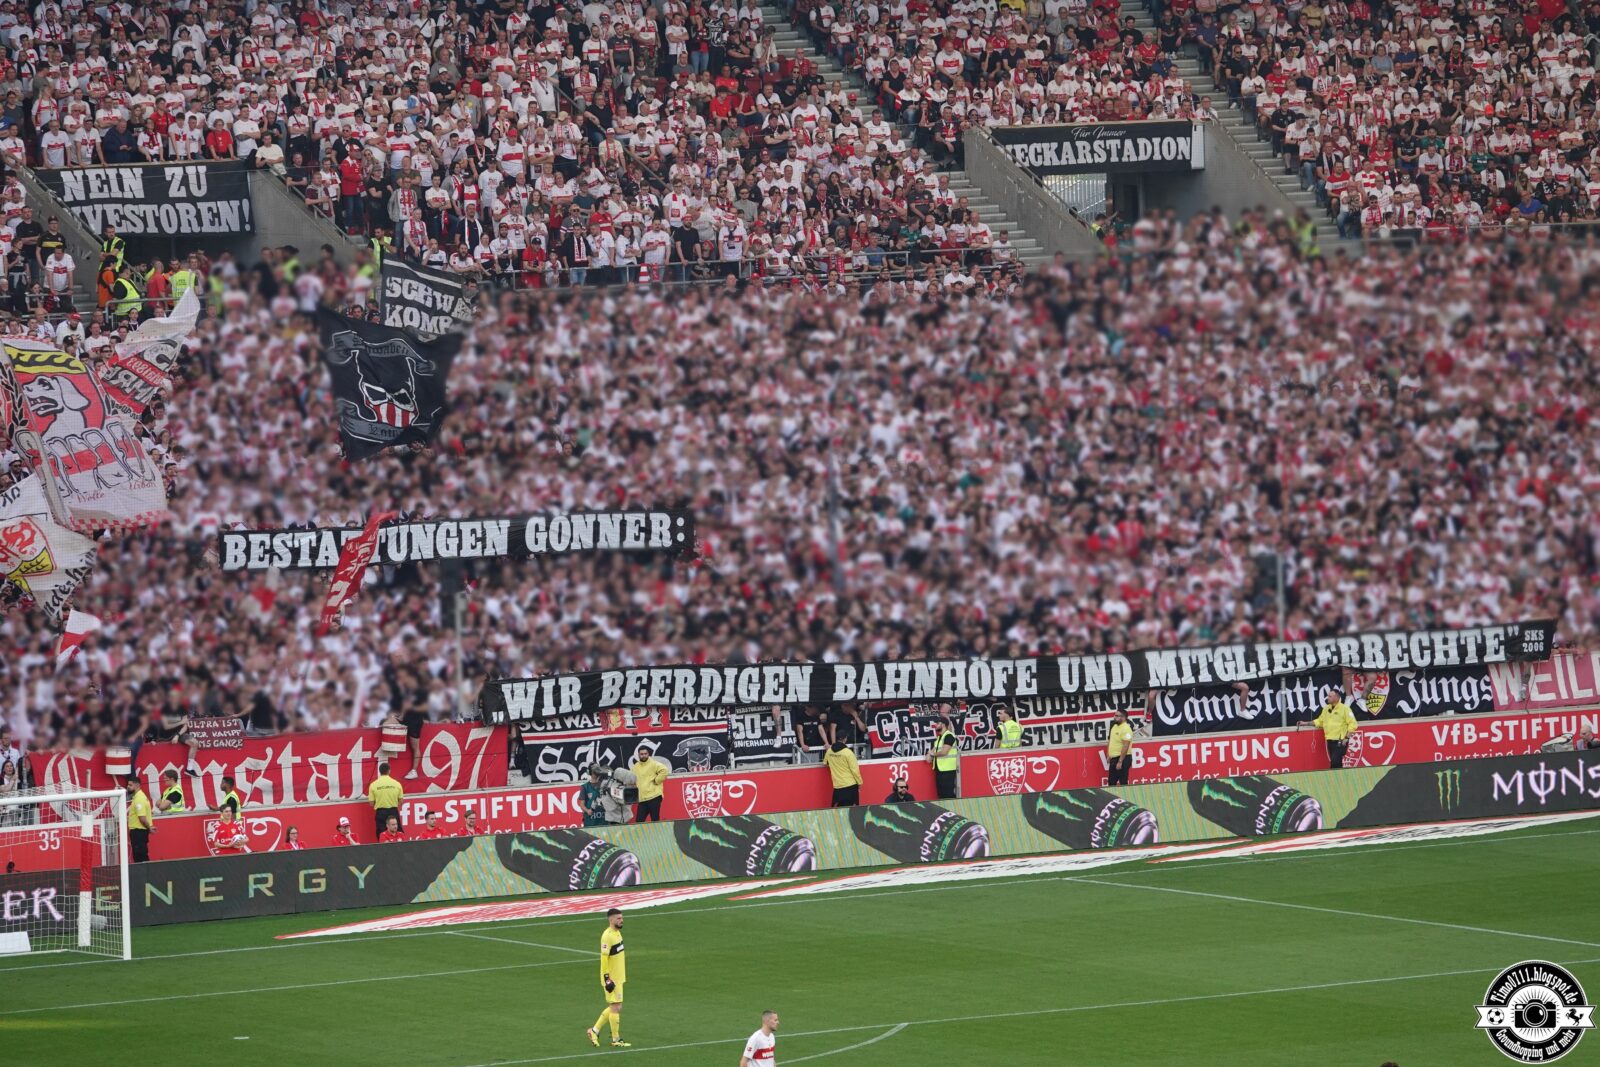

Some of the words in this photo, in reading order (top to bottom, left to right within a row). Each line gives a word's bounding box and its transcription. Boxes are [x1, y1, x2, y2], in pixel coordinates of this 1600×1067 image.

[60, 167, 144, 201] NEIN
[164, 165, 208, 198] ZU
[1522, 642, 1544, 653] 2006
[1524, 629, 1545, 642] SKS
[599, 664, 814, 707] BEERDIGEN
[834, 656, 1037, 701] BAHNHÖFE
[1057, 653, 1133, 693] UND
[1396, 670, 1494, 714] Jungs
[187, 720, 219, 729] ULTRA
[222, 719, 238, 728] IST
[213, 739, 243, 749] GANZE
[1098, 735, 1290, 771] VB-STIFTUNG
[421, 726, 495, 793] 97
[889, 763, 909, 784] 36
[38, 830, 61, 851] 35
[95, 863, 375, 912] ENERGY
